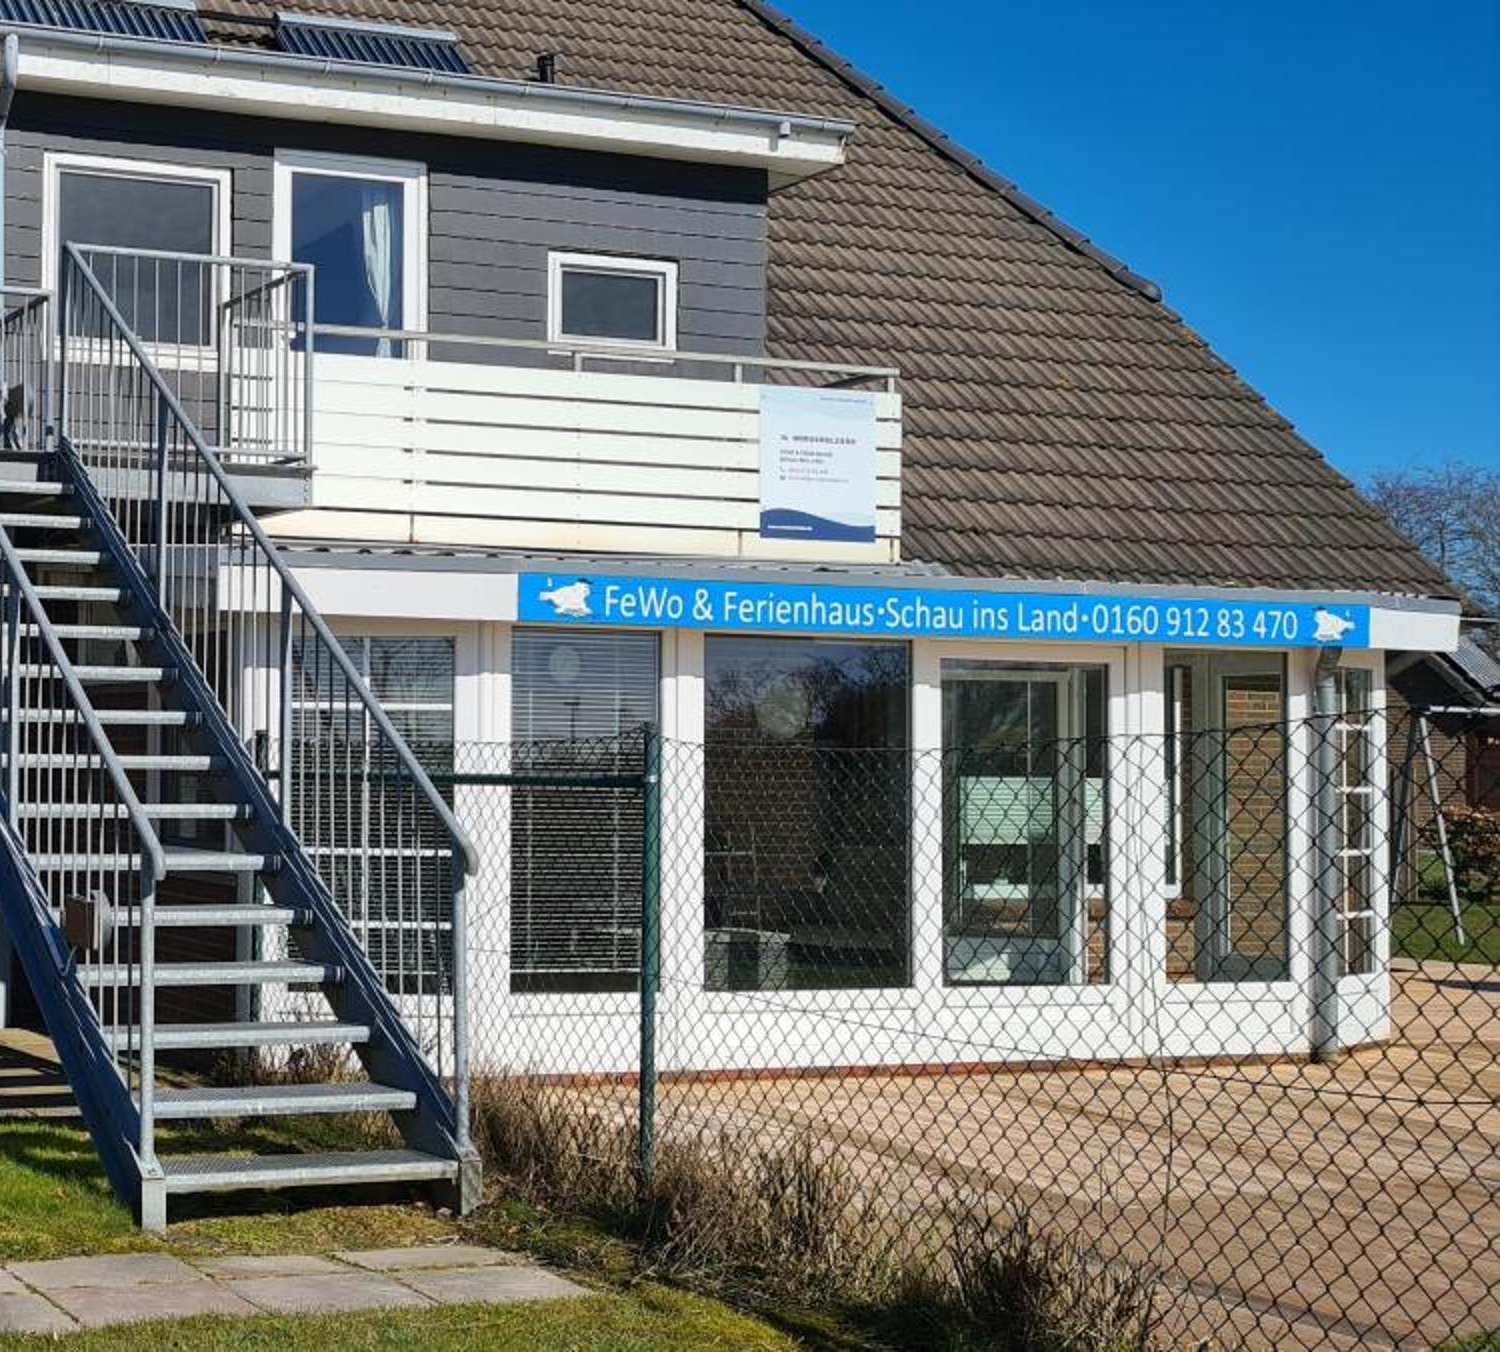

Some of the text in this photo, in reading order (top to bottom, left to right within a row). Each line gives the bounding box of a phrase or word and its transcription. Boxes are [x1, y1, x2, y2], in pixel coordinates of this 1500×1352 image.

[604, 586, 684, 619] FeWo
[692, 588, 714, 622] &
[973, 599, 1009, 632] ins
[1166, 608, 1211, 637] 912
[1217, 609, 1246, 640] 83
[1252, 610, 1299, 640] 470
